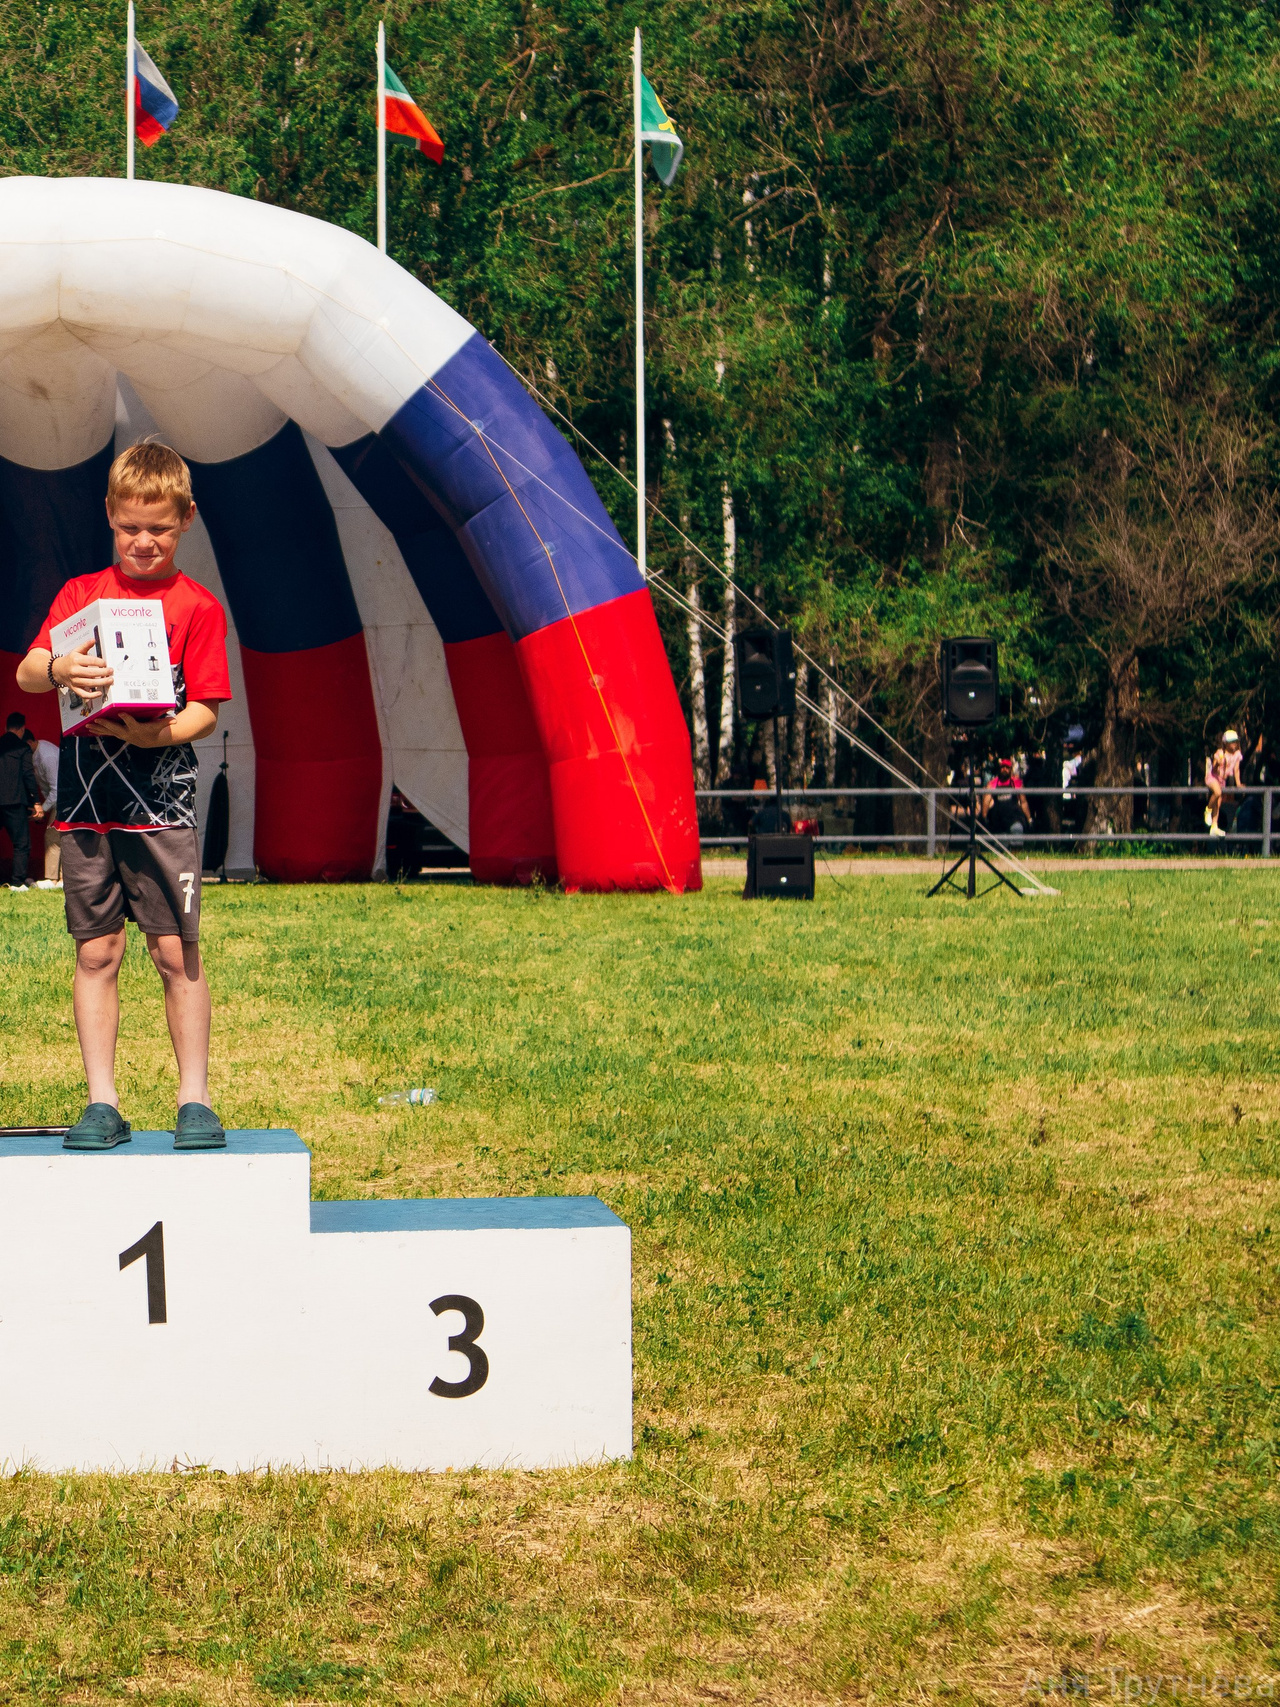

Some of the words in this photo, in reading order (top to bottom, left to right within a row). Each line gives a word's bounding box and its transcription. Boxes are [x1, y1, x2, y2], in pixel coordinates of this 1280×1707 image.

[63, 618, 87, 638] viconte
[110, 606, 153, 617] viconte
[178, 872, 195, 914] 7
[118, 1220, 167, 1325] 1
[427, 1293, 490, 1400] 3
